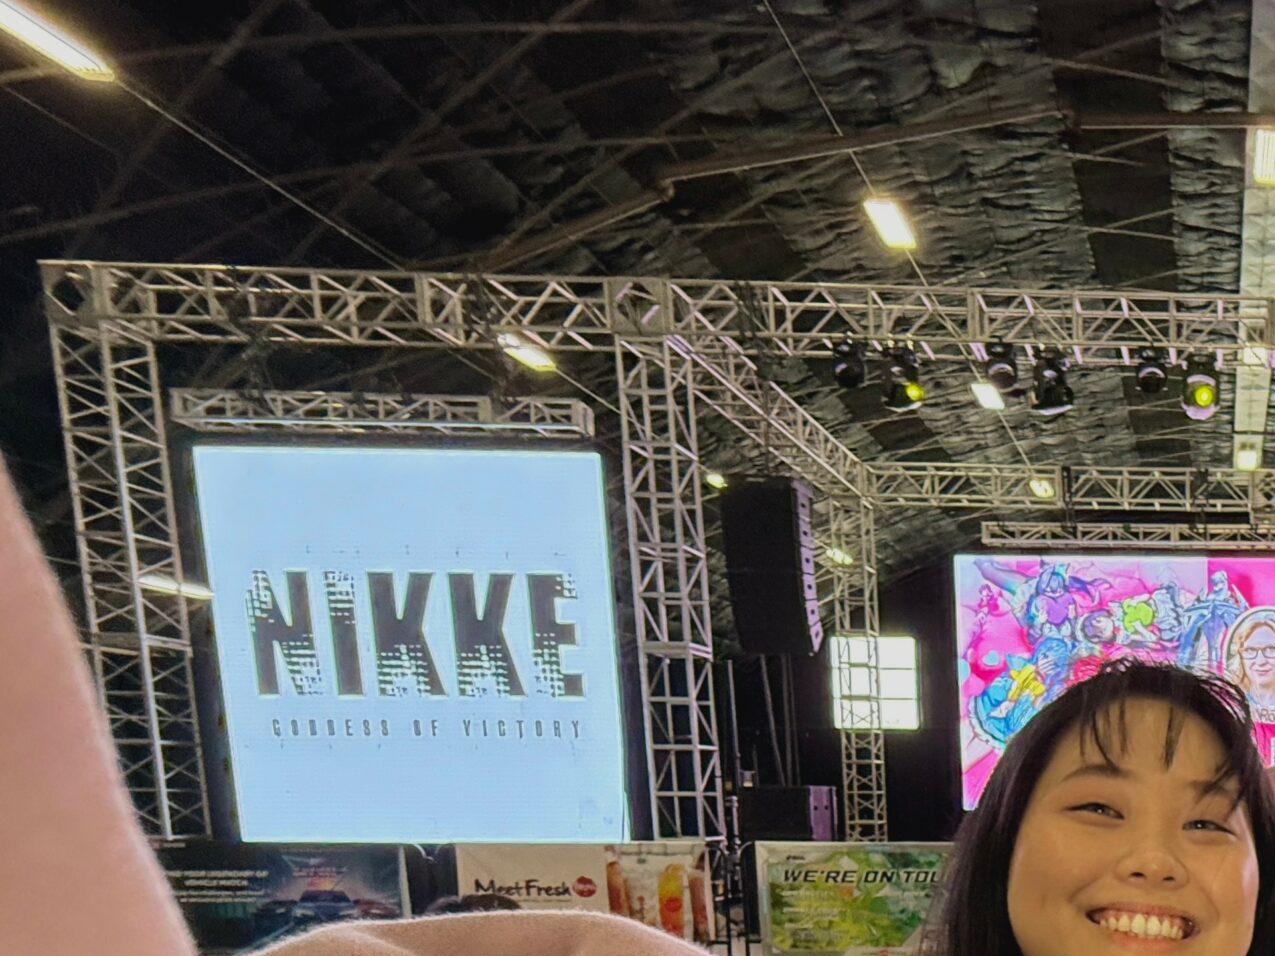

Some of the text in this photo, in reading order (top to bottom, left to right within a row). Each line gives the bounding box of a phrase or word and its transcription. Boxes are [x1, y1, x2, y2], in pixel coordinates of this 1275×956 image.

[246, 570, 586, 697] NIKKE
[272, 719, 582, 739] GODDESS OF VICTORY
[783, 869, 858, 884] WE'RE
[864, 869, 897, 884] ON
